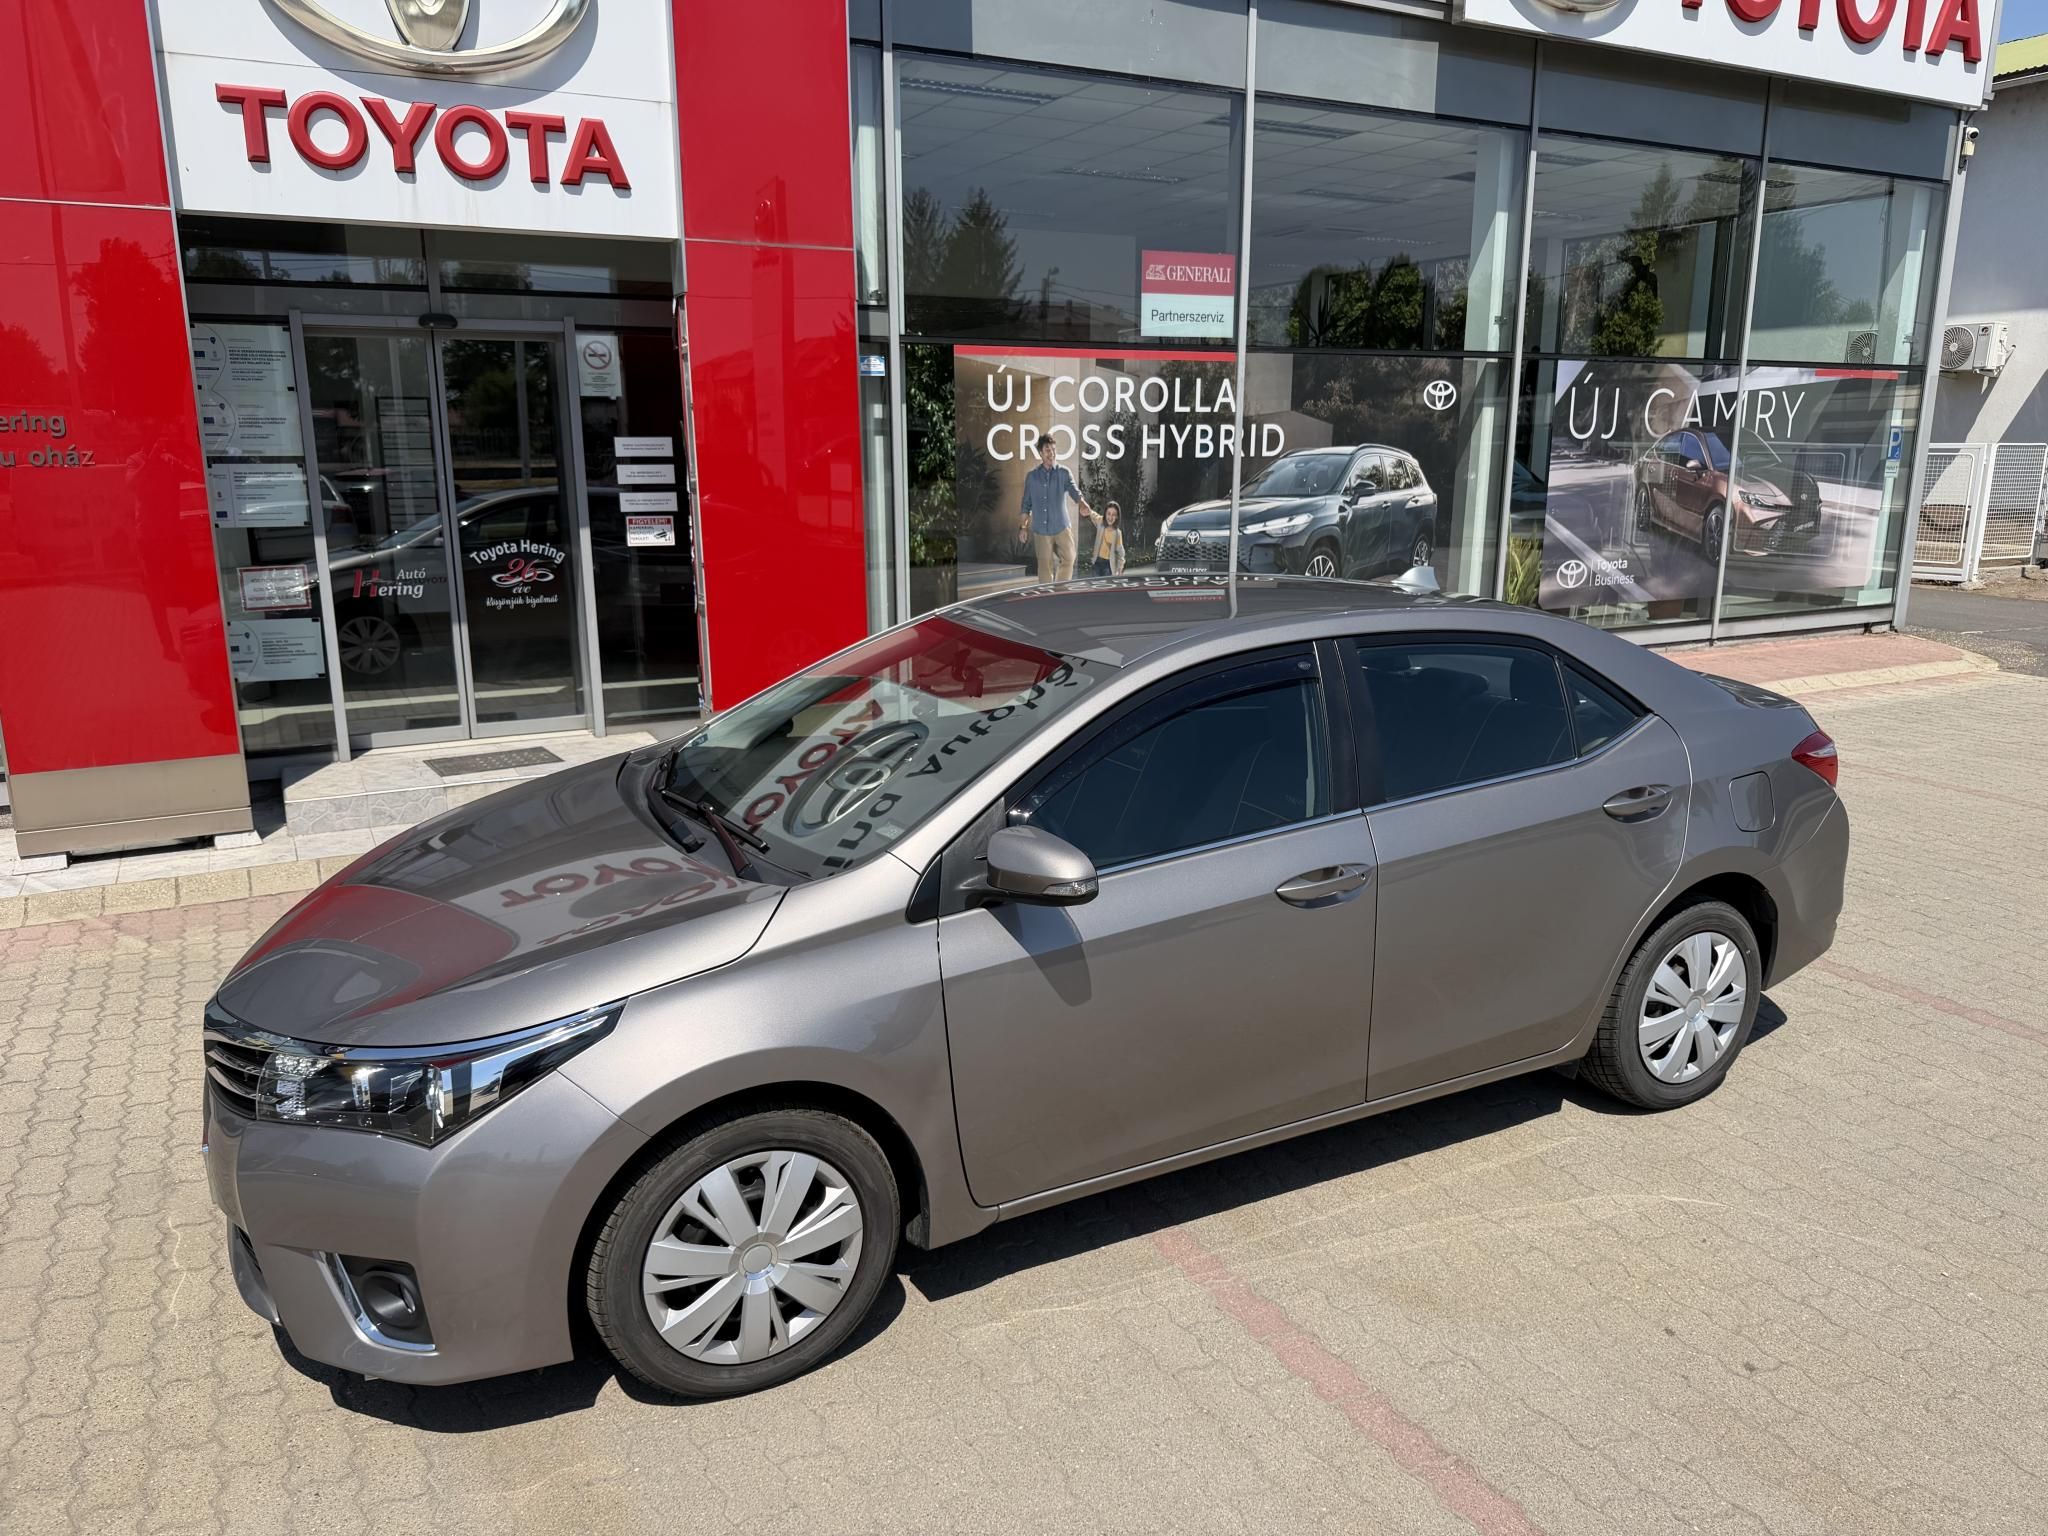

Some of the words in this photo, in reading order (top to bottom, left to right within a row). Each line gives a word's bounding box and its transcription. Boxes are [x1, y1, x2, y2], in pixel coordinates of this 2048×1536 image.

[216, 83, 631, 190] TOYOTA
[1167, 265, 1232, 283] GENERALI
[1151, 309, 1225, 323] Partnerszerviz
[987, 365, 1032, 413] ÚJ
[1049, 377, 1236, 413] COROLLA
[1569, 372, 1620, 440] ÚJ
[1644, 388, 1806, 439] CAMRY
[987, 423, 1126, 461] CROSS
[1142, 423, 1286, 459] HYBRID
[469, 542, 518, 565] Toyota
[520, 539, 566, 564] Hering
[396, 568, 426, 580] Autó
[500, 558, 539, 582] 26
[1597, 558, 1628, 572] Toyota
[353, 568, 424, 598] Hering
[1594, 574, 1635, 586] Business
